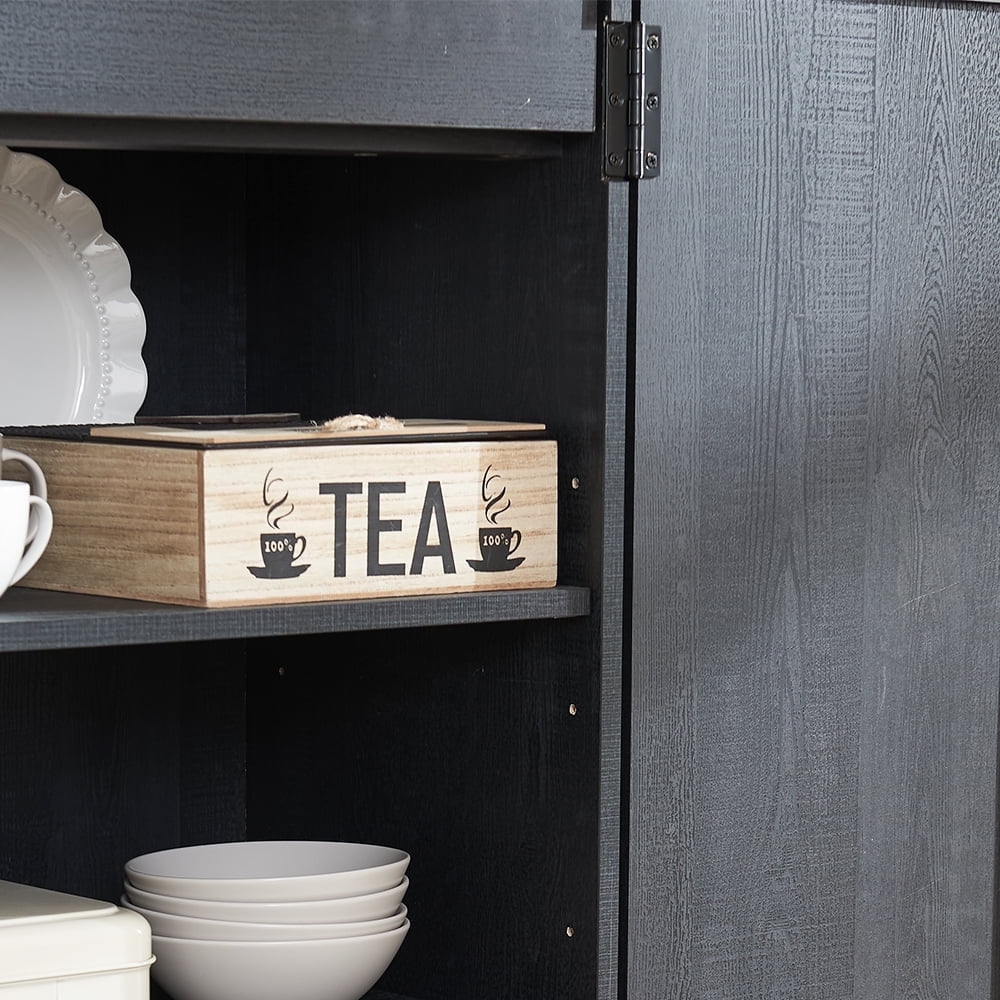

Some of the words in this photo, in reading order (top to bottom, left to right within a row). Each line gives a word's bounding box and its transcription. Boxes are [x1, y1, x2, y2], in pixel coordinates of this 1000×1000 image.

[319, 481, 456, 578] TEA
[265, 538, 293, 552] 100%
[483, 533, 509, 546] 100%
